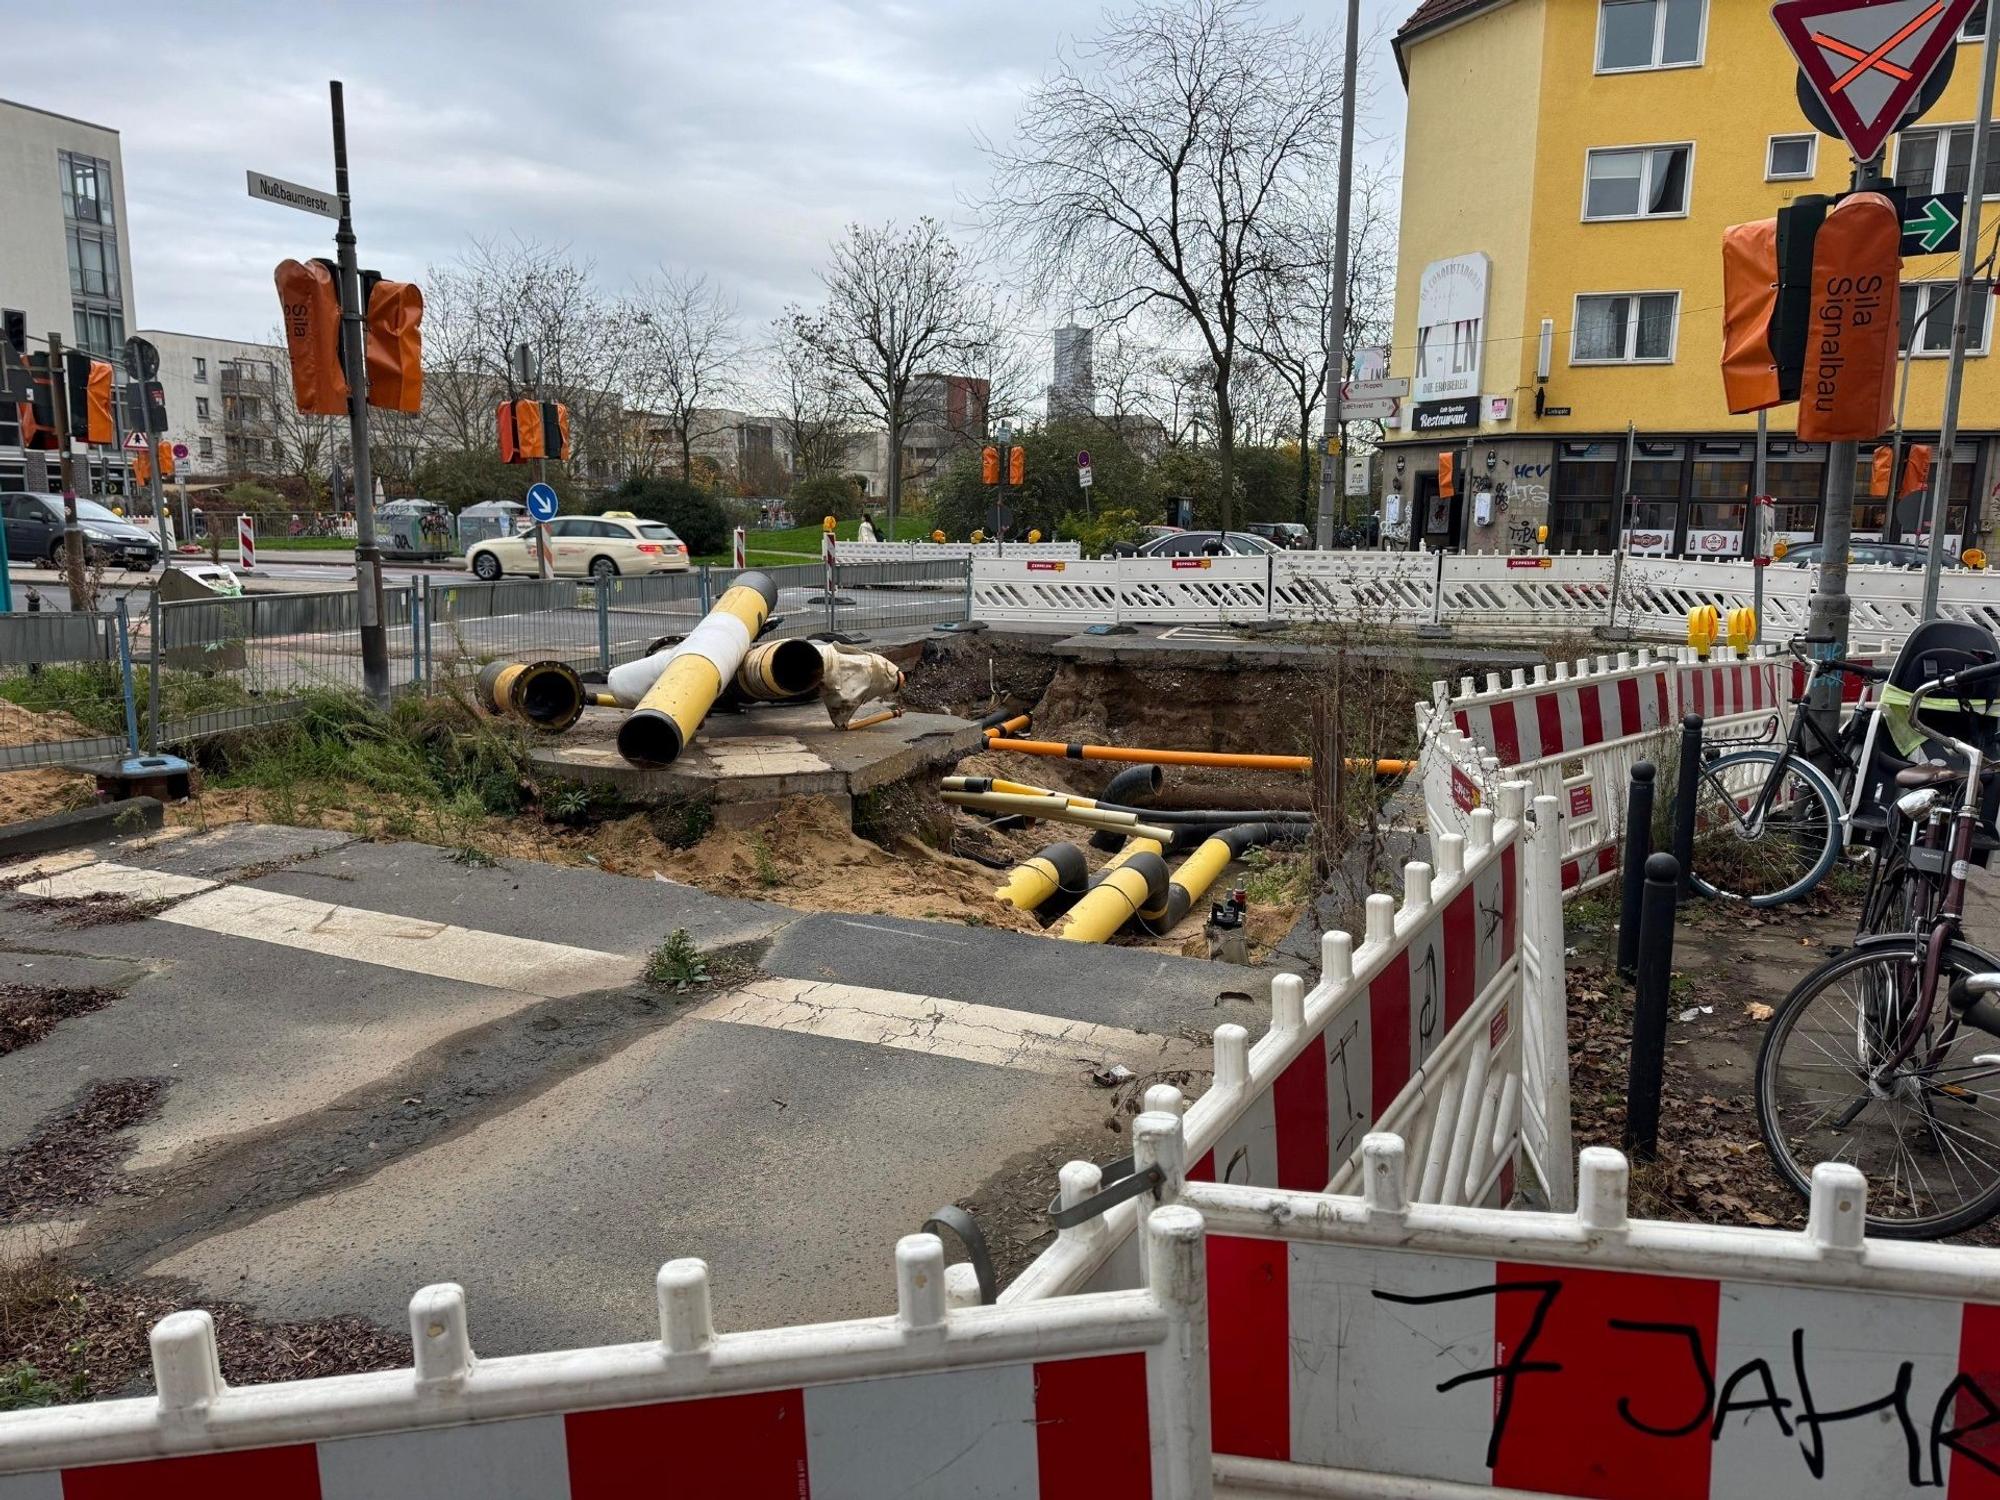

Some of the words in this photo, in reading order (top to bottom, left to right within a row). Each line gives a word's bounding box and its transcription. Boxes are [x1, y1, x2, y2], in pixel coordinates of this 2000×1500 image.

[260, 179, 330, 212] Nußbaumerstr.
[292, 303, 308, 338] Sila
[1852, 275, 1883, 327] Sila
[1815, 276, 1853, 412] Signalbau
[1420, 412, 1468, 428] Restaurant
[1371, 1280, 1563, 1469] 7
